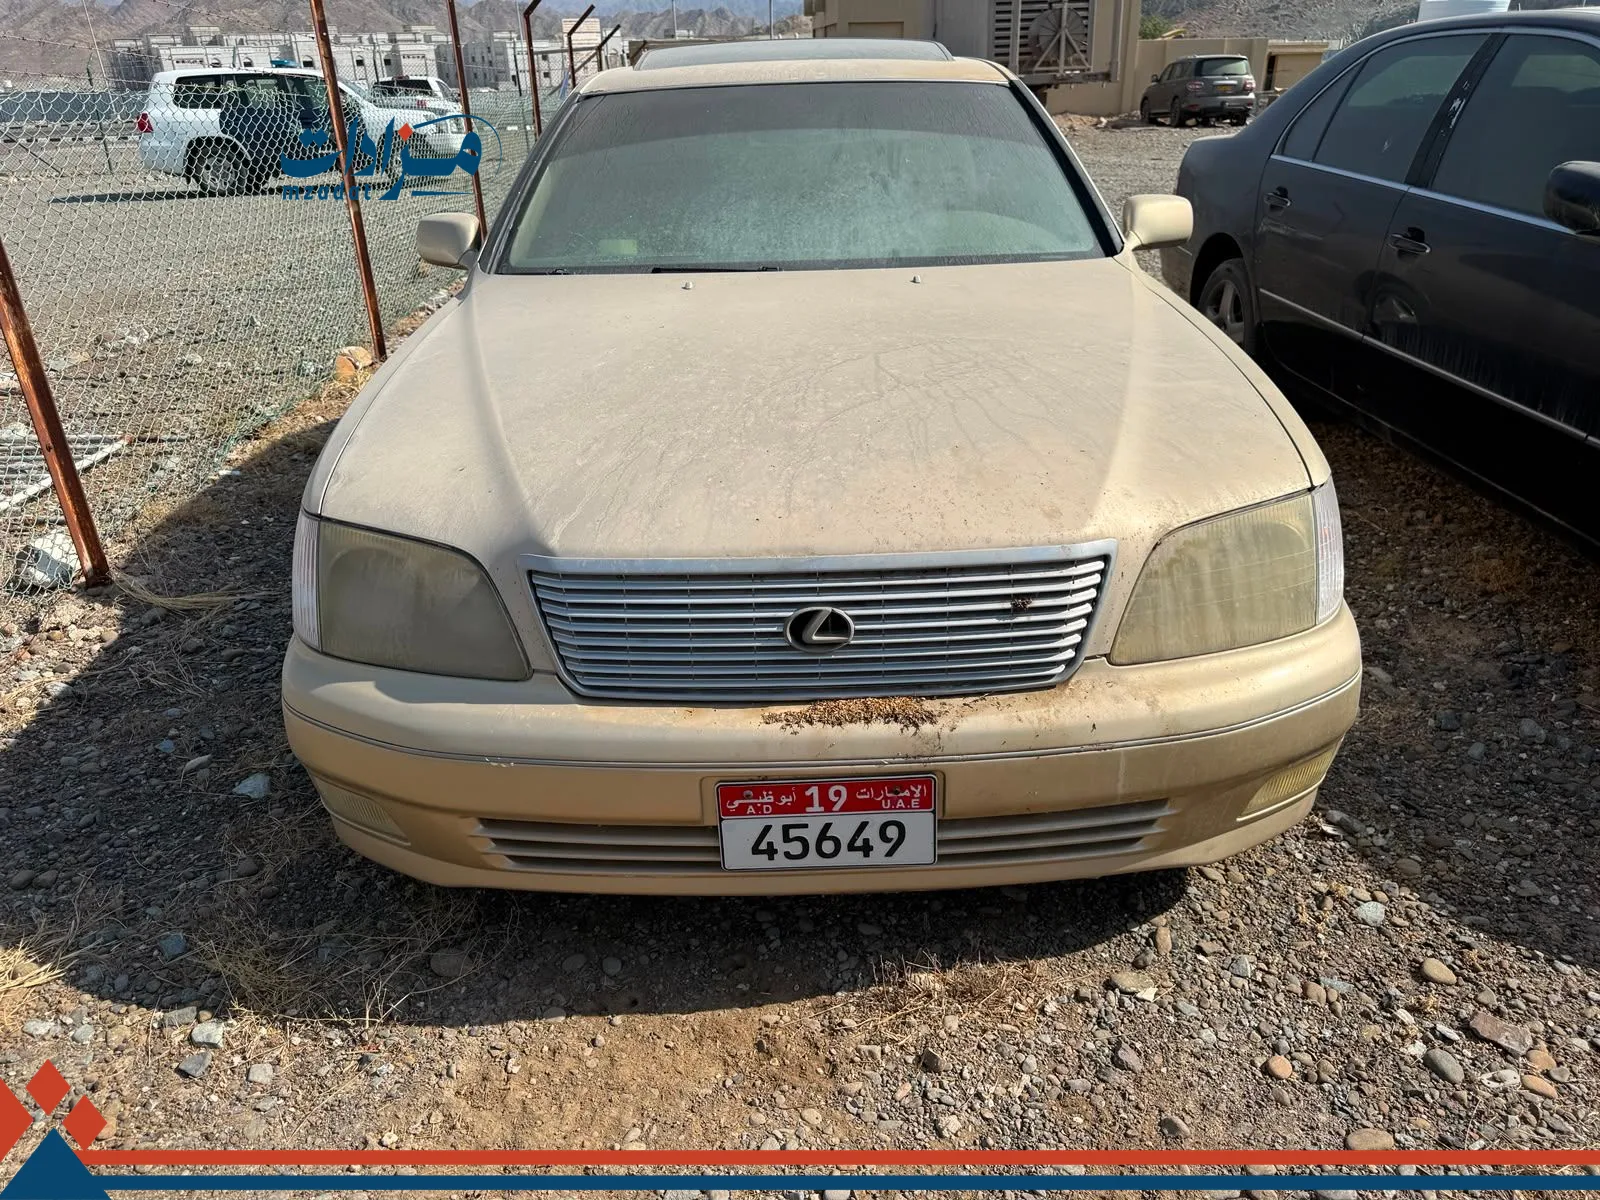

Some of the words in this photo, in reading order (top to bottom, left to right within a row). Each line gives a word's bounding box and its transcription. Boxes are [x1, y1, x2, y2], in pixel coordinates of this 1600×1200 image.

[726, 791, 774, 811] ظبي
[775, 787, 796, 805] أبو
[804, 785, 848, 812] 19
[882, 799, 920, 808] U.A.E
[751, 820, 906, 861] 45649
